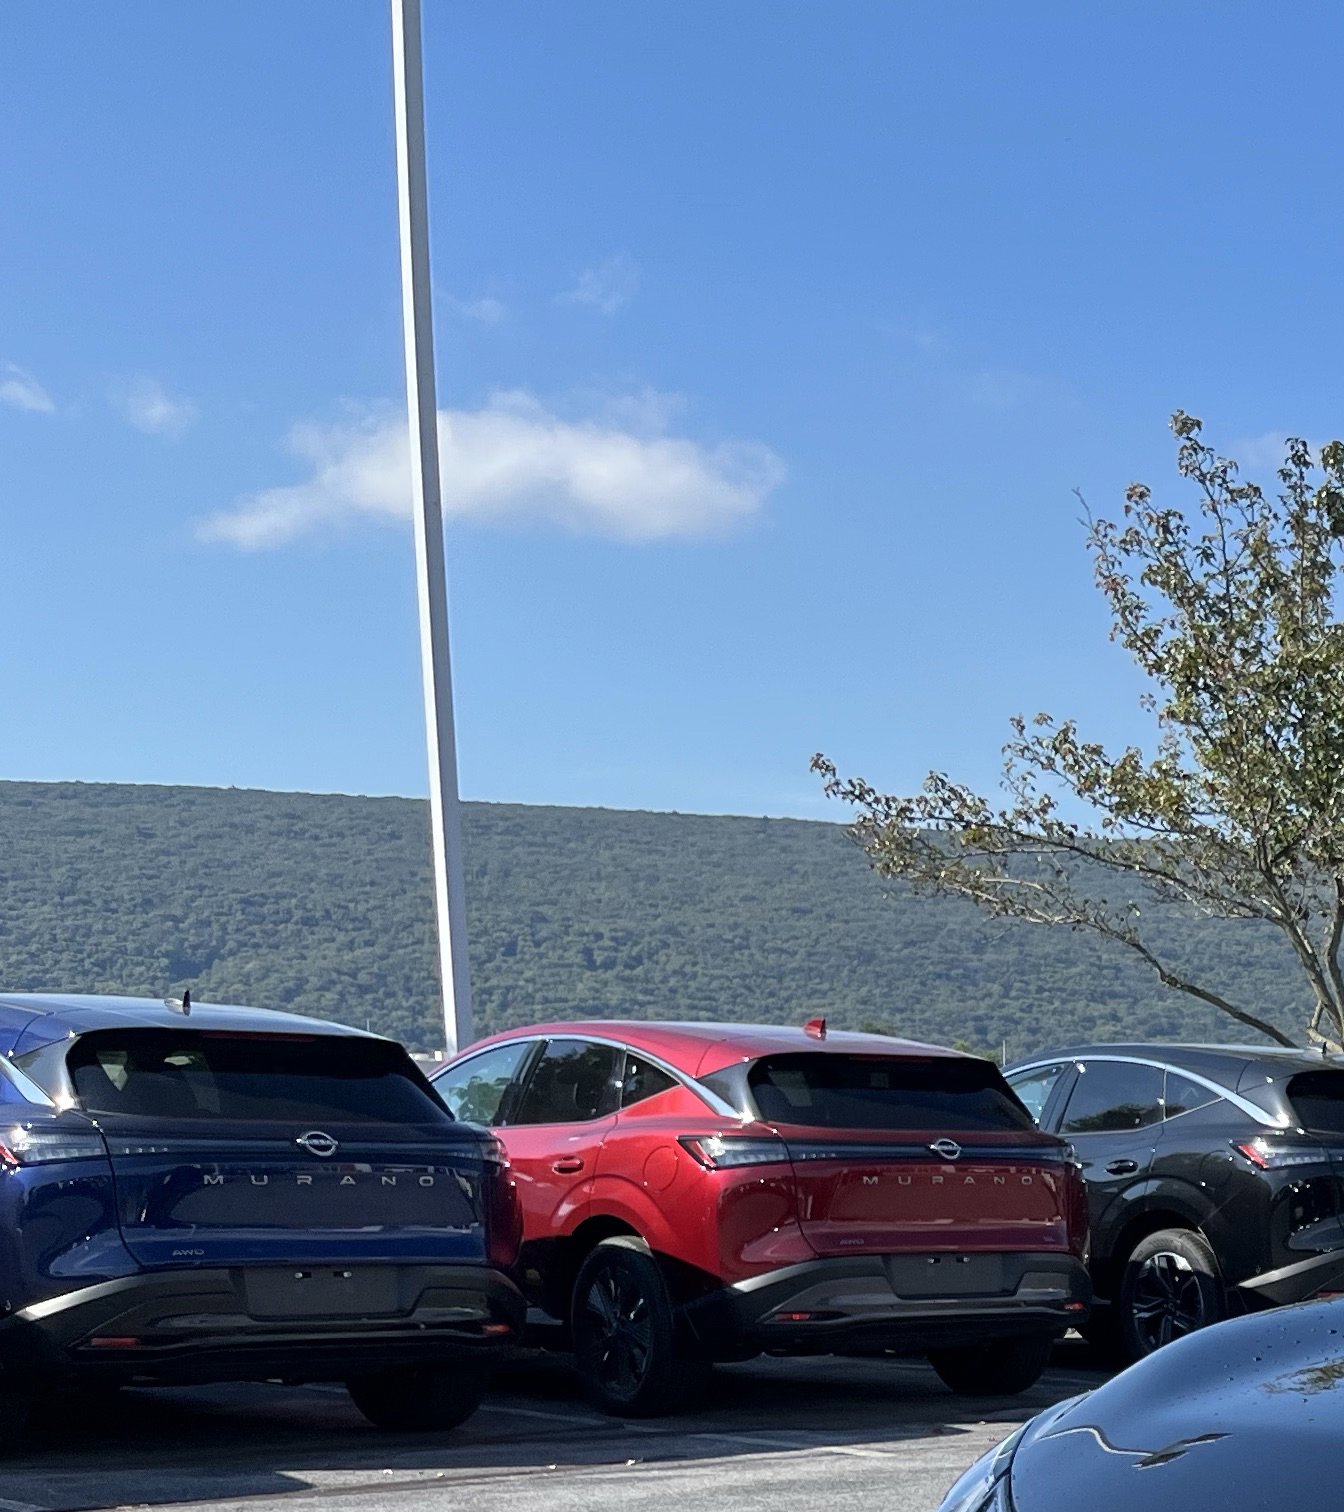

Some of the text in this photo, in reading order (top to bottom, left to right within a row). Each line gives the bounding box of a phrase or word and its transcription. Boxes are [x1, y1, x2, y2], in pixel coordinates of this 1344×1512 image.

[203, 1174, 434, 1187] MURANO
[863, 1175, 1033, 1186] MURANO
[172, 1248, 205, 1257] AWD
